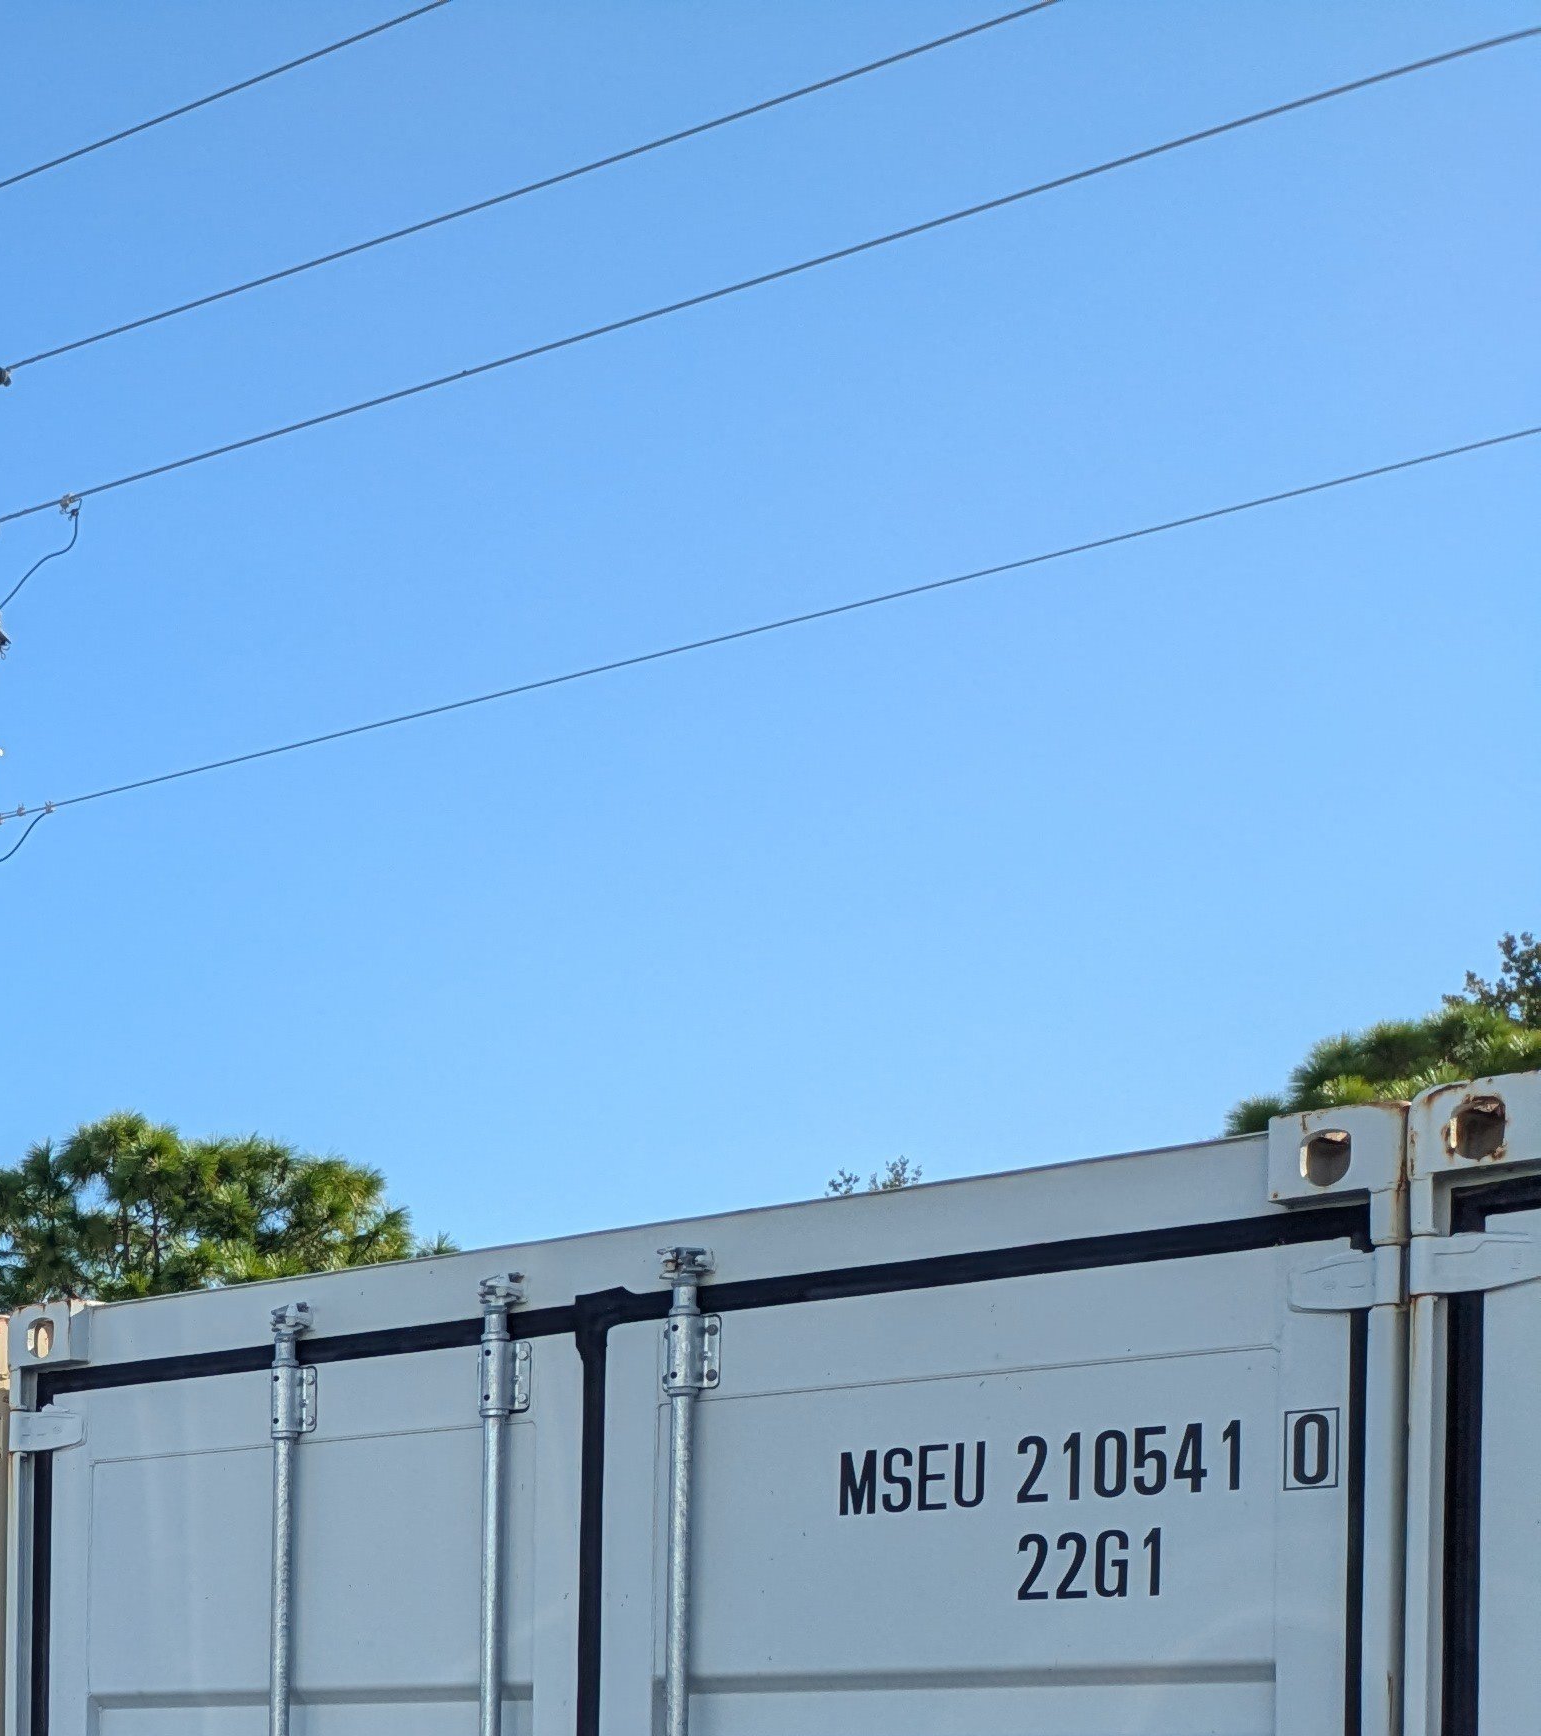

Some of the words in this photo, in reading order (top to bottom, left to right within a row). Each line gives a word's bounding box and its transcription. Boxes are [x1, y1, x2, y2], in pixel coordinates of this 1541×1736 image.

[840, 1441, 985, 1515] MSEU
[1017, 1420, 1240, 1503] 210541
[1294, 1414, 1329, 1484] 0
[1017, 1527, 1161, 1600] 22G1
